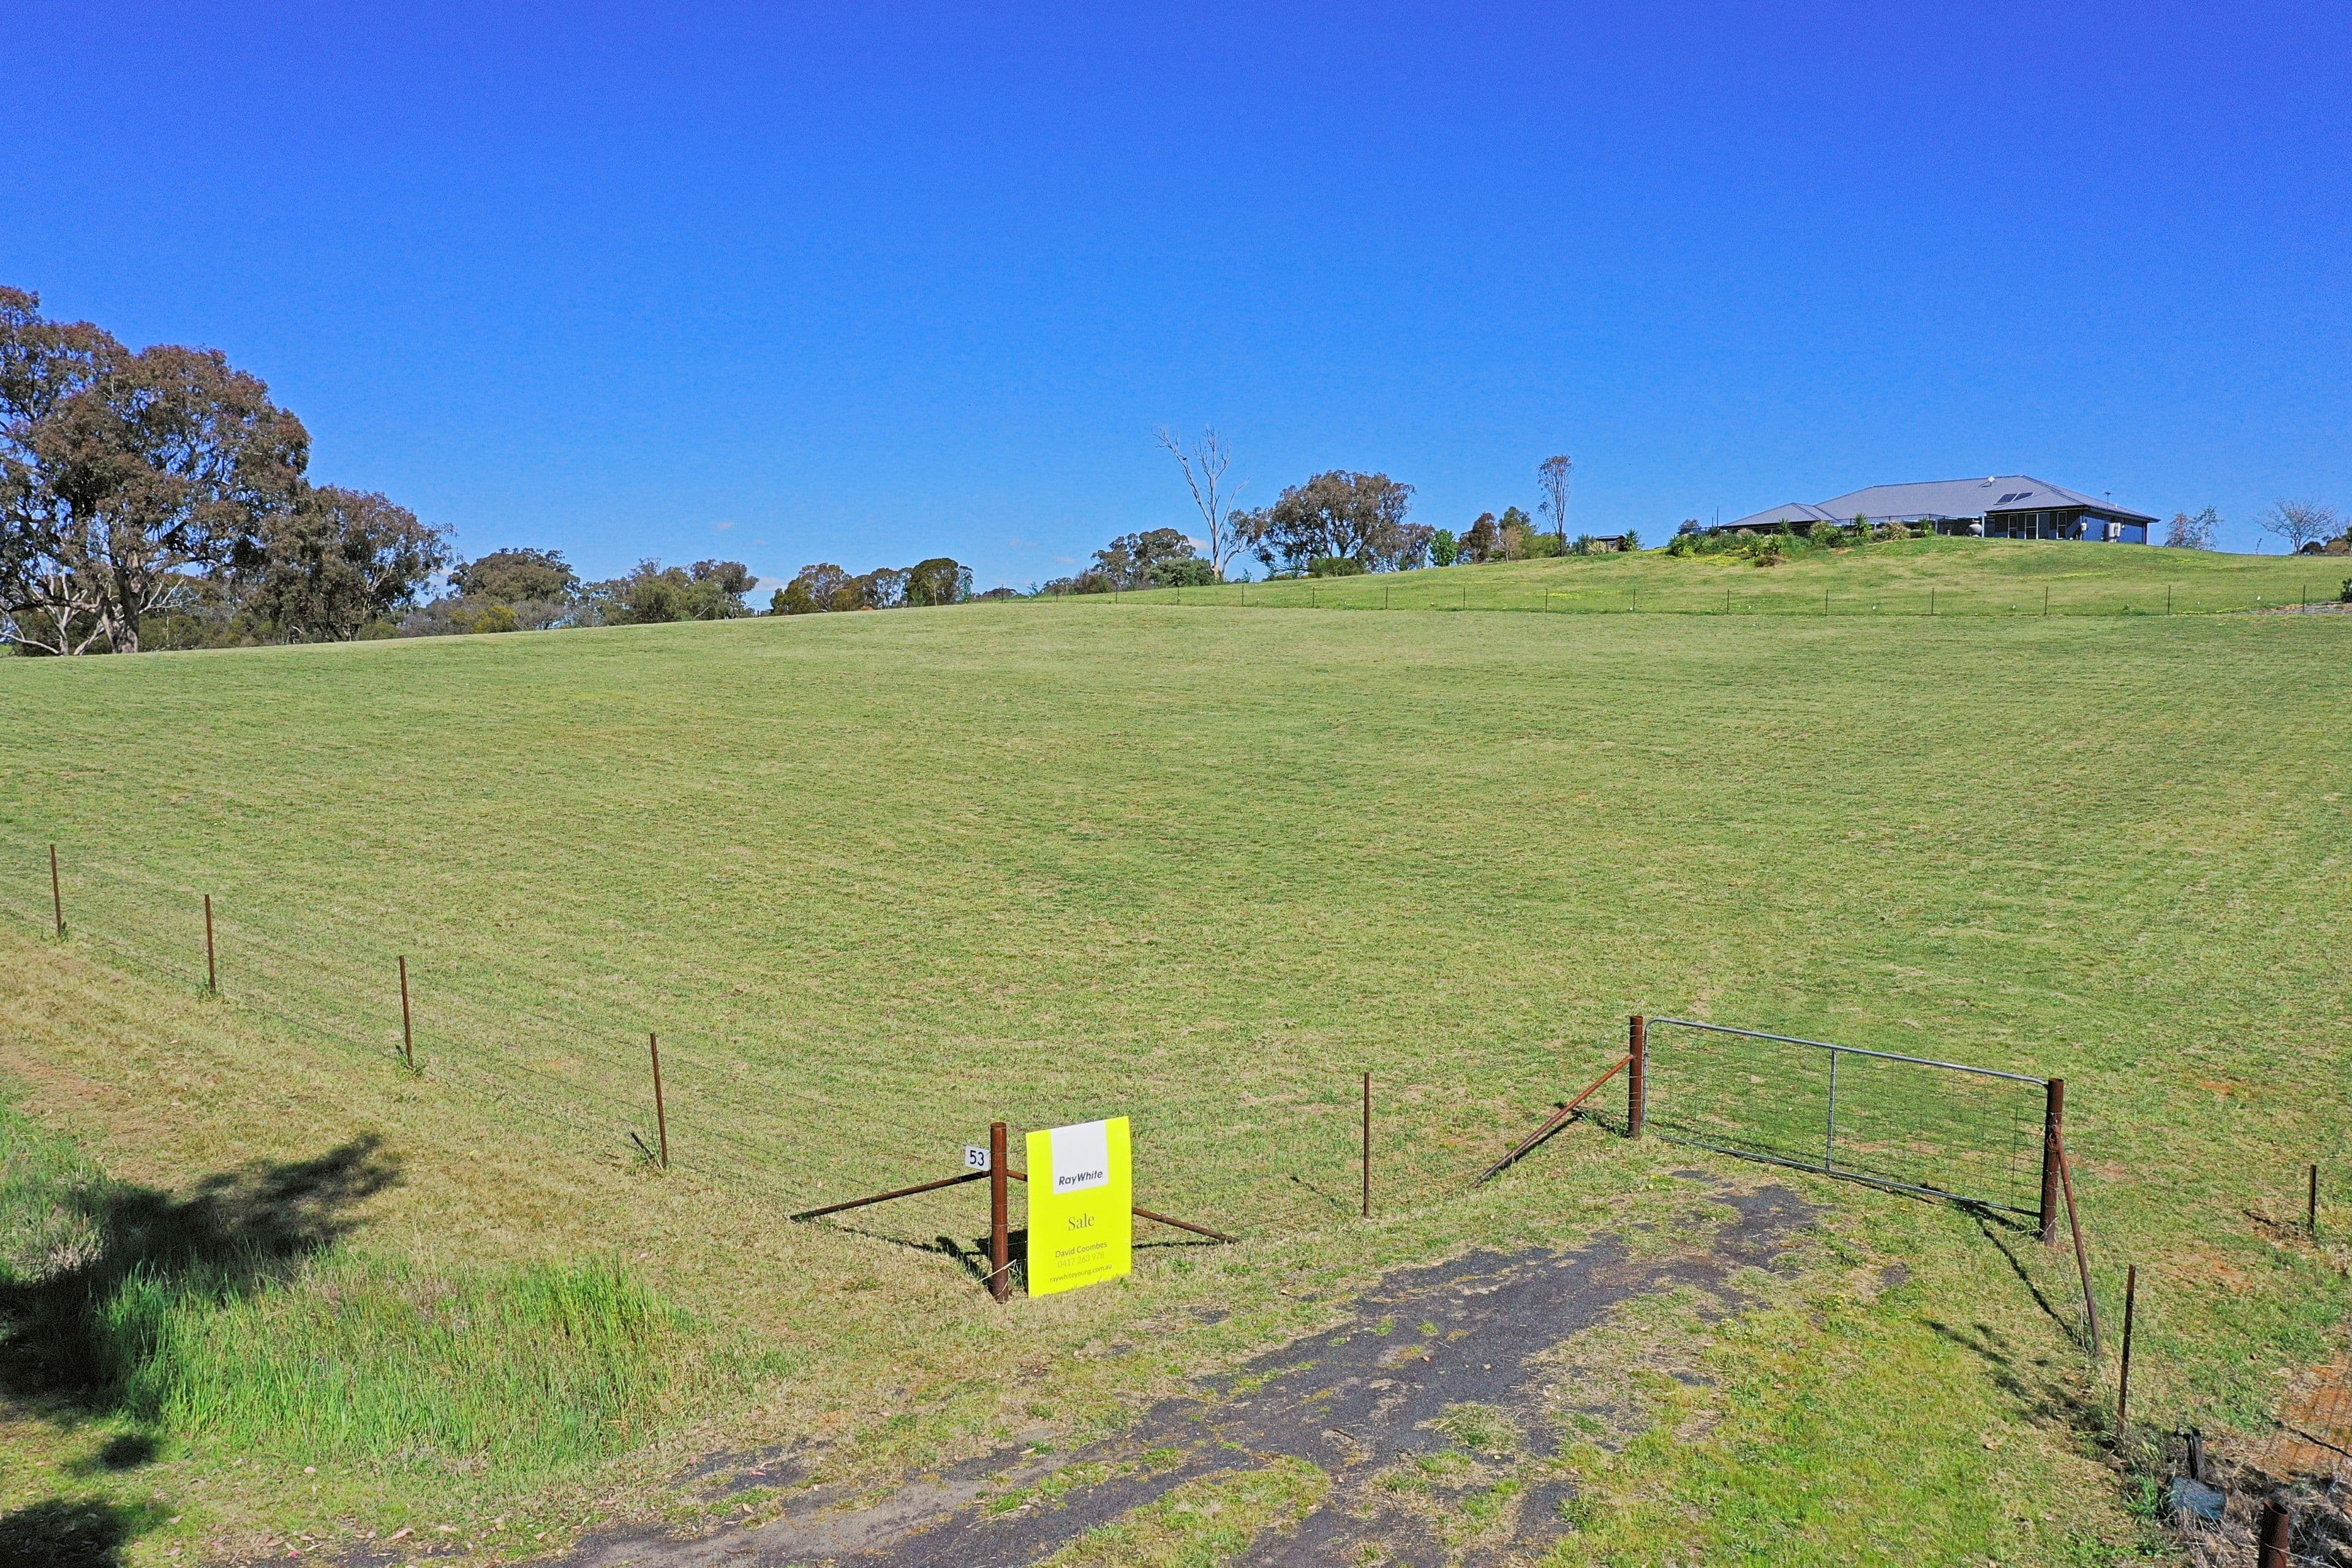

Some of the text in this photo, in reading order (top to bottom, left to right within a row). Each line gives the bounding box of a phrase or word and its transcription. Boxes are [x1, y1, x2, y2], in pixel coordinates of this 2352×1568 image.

[970, 1150, 984, 1166] 53
[1068, 1213, 1095, 1231] Sale
[1055, 1242, 1107, 1258] David Coombes
[1057, 1257, 1076, 1268] 0417
[1077, 1255, 1091, 1264] 263
[1049, 1264, 1112, 1283] raywhiteyoung.com.au
